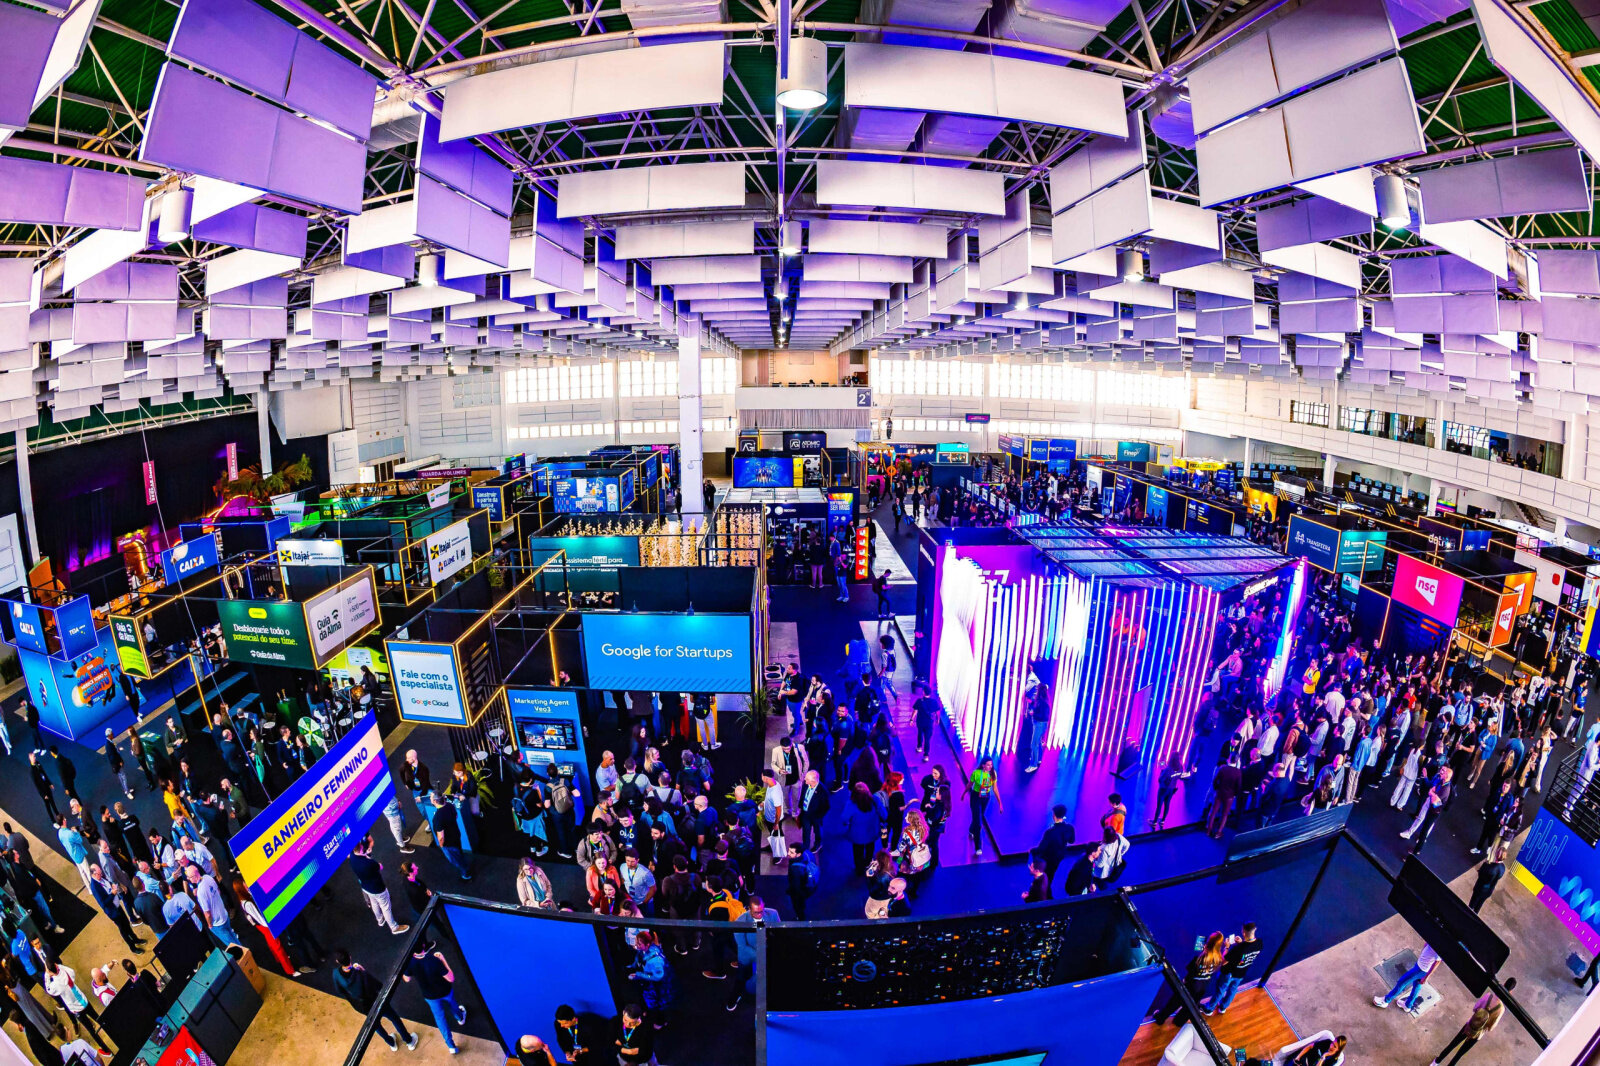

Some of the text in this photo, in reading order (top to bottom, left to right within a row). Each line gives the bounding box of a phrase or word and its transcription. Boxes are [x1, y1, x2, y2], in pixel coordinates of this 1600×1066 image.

[179, 555, 205, 573] CAIXA
[608, 557, 623, 565] para
[1417, 579, 1436, 594] nsc
[316, 615, 331, 630] Guia
[1500, 612, 1511, 622] nsc
[233, 623, 270, 634] Desbloqueie
[269, 626, 285, 636] todo
[319, 620, 342, 641] da Alma
[232, 633, 260, 642] potencial
[260, 634, 268, 643] do
[281, 636, 298, 646] time.
[601, 643, 733, 661] Google for Startups
[400, 669, 419, 679] Fale
[400, 679, 453, 691] especialista
[410, 697, 449, 707] Google Cloud
[514, 697, 548, 706] Marketing
[262, 746, 369, 859] BANHEIRO FEMININO
[322, 829, 344, 855] Startup
